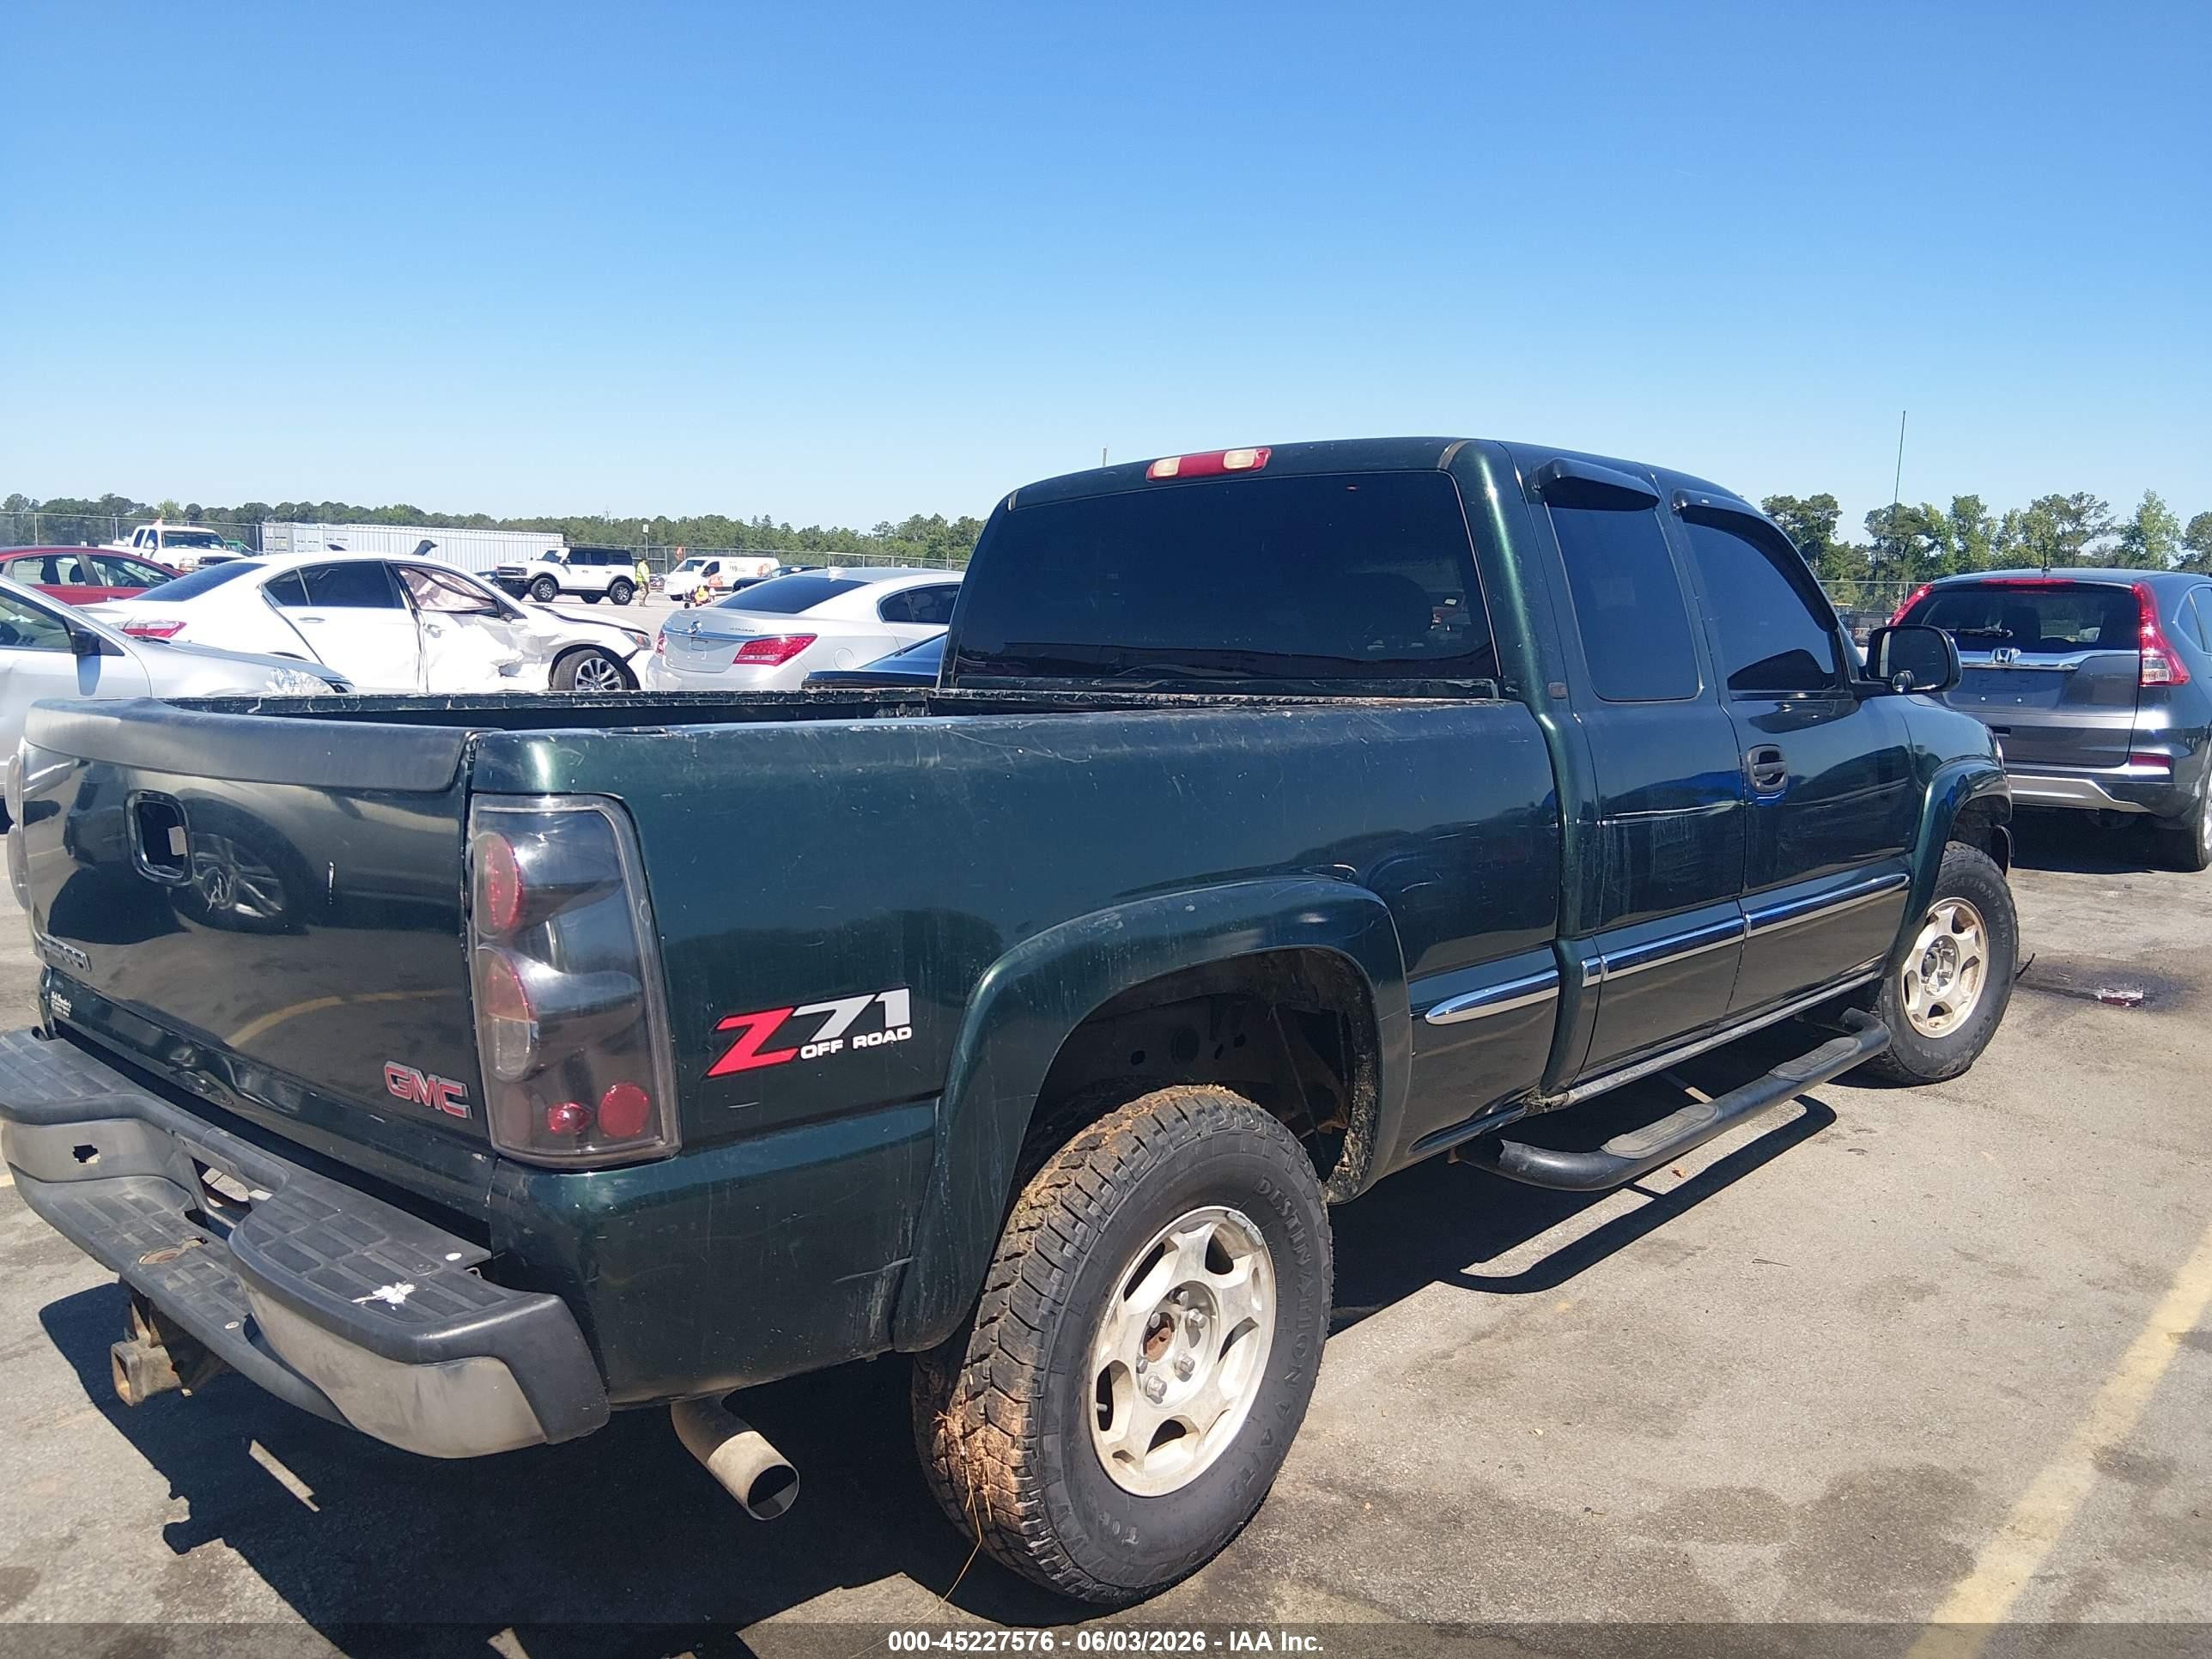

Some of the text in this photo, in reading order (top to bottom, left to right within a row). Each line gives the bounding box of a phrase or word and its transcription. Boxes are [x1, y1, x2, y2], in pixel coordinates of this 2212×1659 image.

[707, 988, 912, 1077] Z71
[800, 1026, 912, 1060] OFF ROAD
[384, 1060, 473, 1120] GMC
[1255, 1174, 1315, 1389] DESTINATION
